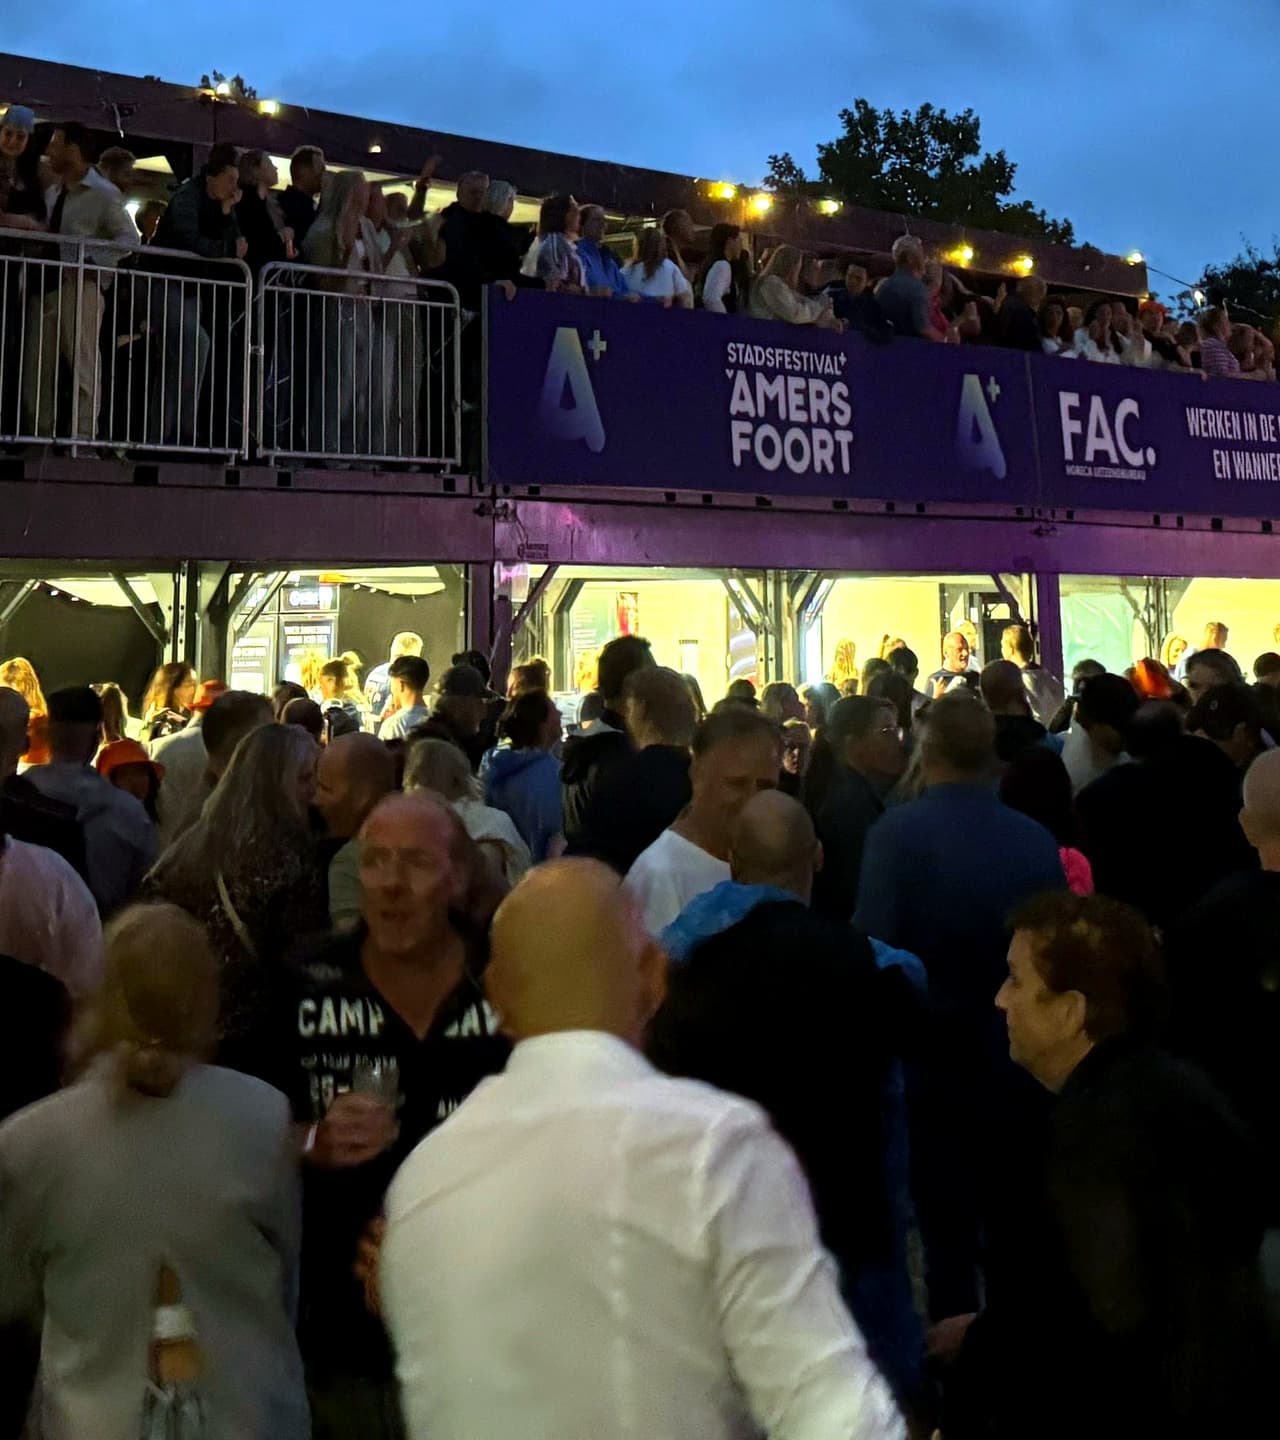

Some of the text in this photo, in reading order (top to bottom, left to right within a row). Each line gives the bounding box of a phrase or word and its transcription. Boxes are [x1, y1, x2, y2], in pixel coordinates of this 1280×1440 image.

[729, 369, 852, 426] AMERS
[1186, 407, 1241, 440] WERKEN
[1242, 411, 1258, 441] IN
[1259, 413, 1277, 442] DE
[731, 419, 854, 474] FOORT
[1058, 391, 1156, 466] FAC.
[1213, 448, 1231, 479] EN
